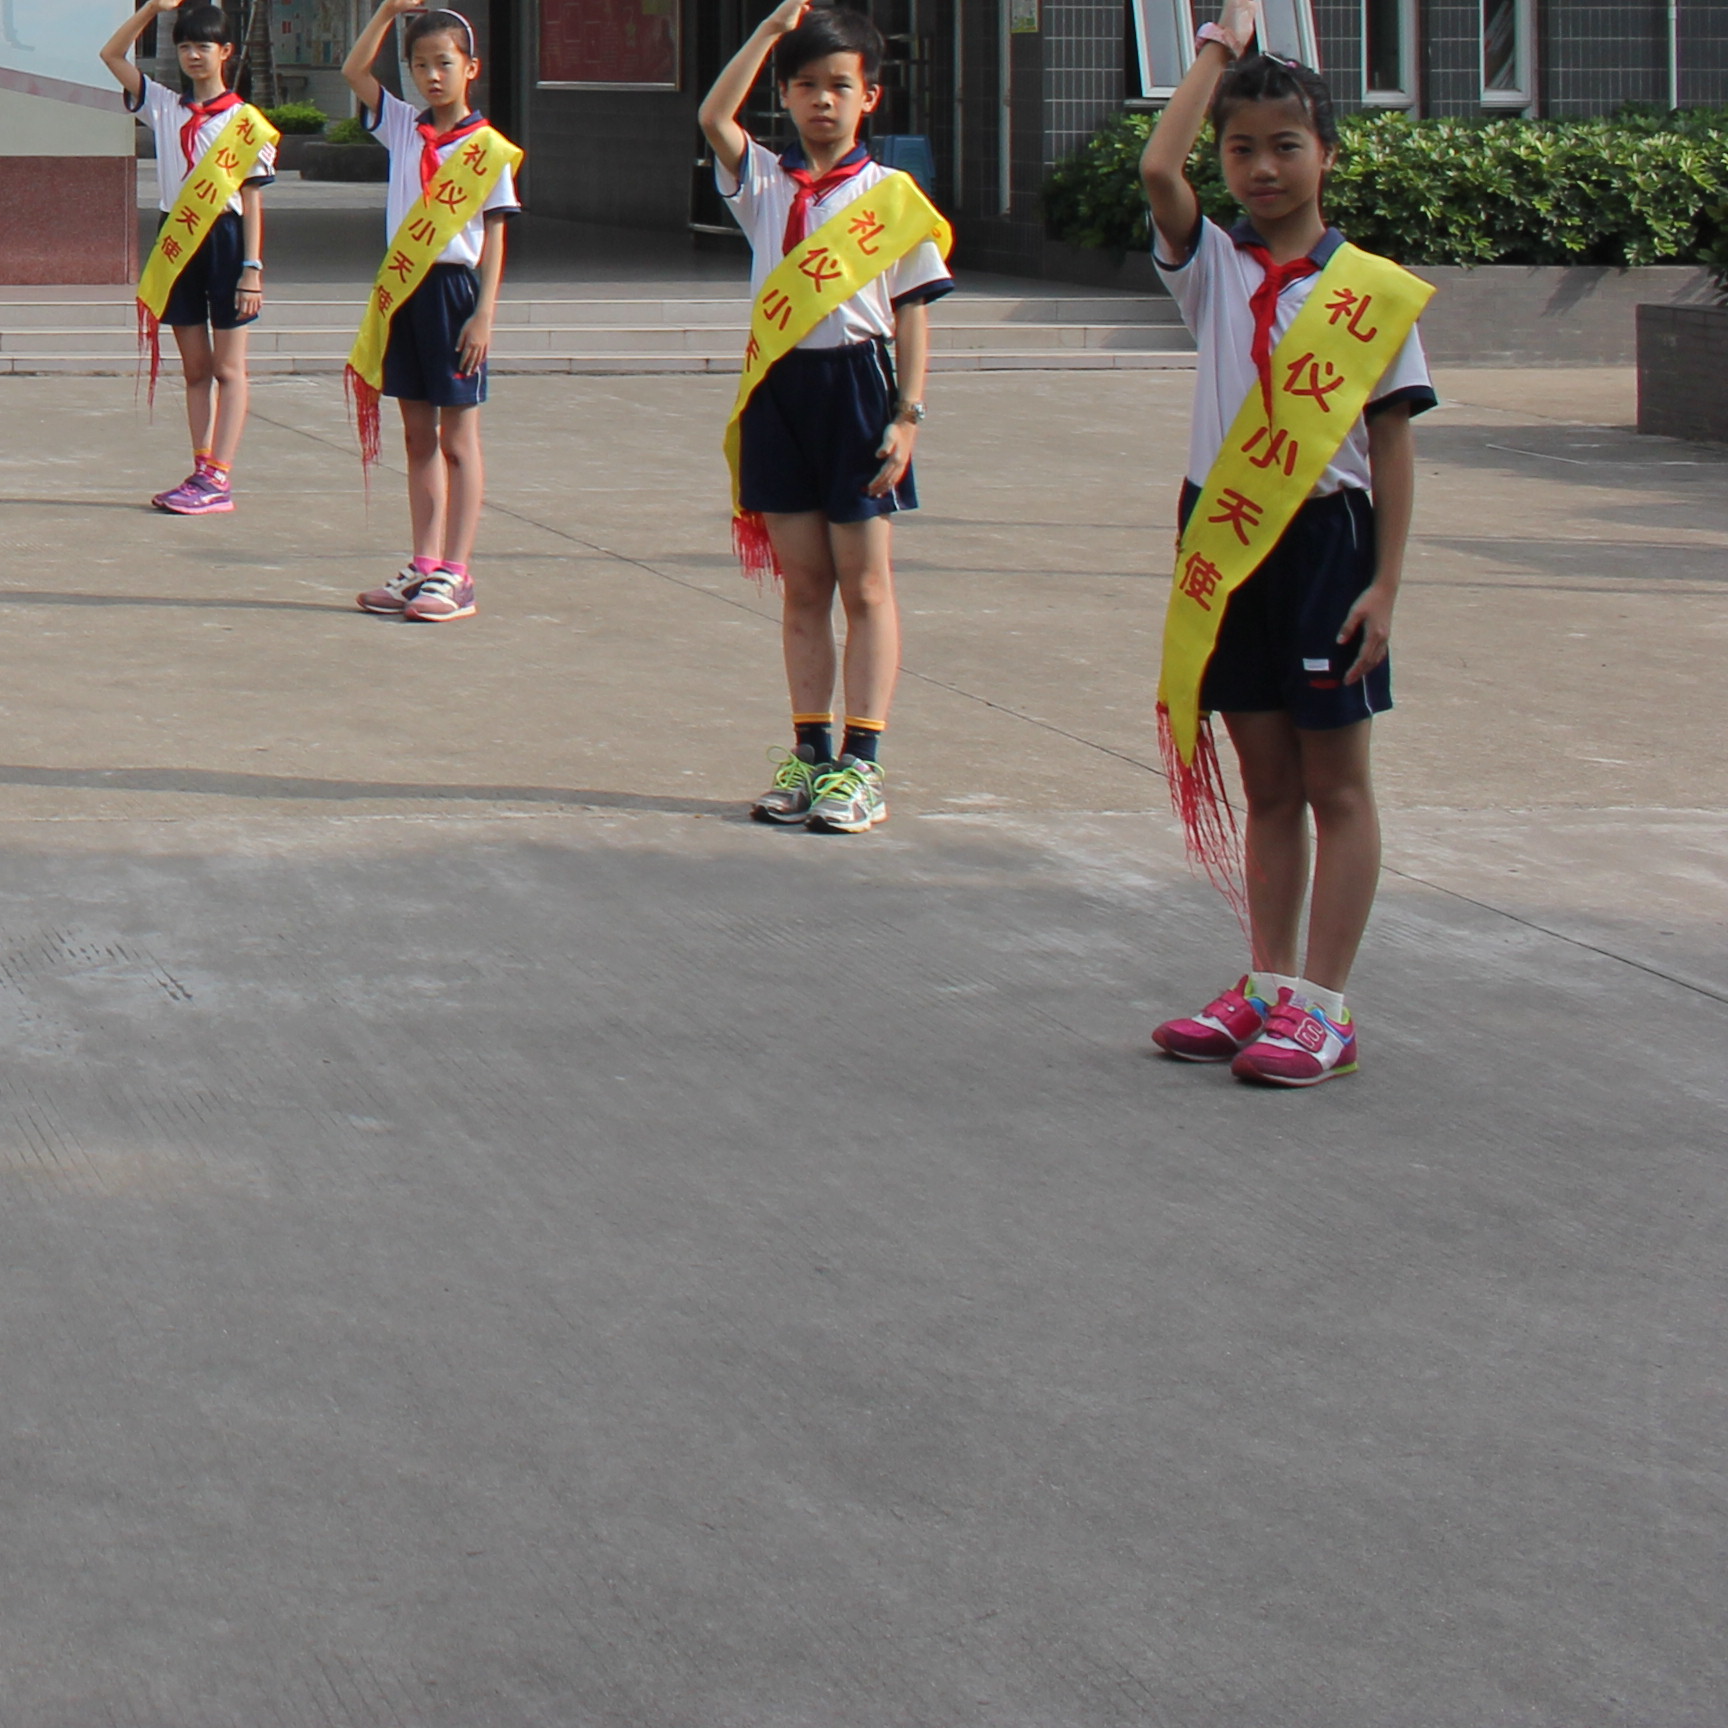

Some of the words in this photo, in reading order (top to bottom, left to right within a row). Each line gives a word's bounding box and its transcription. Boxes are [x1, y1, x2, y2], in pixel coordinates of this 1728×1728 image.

[160, 117, 256, 264] 礼仪小天使
[373, 143, 487, 319] 礼仪小天使
[738, 209, 885, 397] 礼仪小天
[1178, 286, 1378, 612] 礼仪小天使
